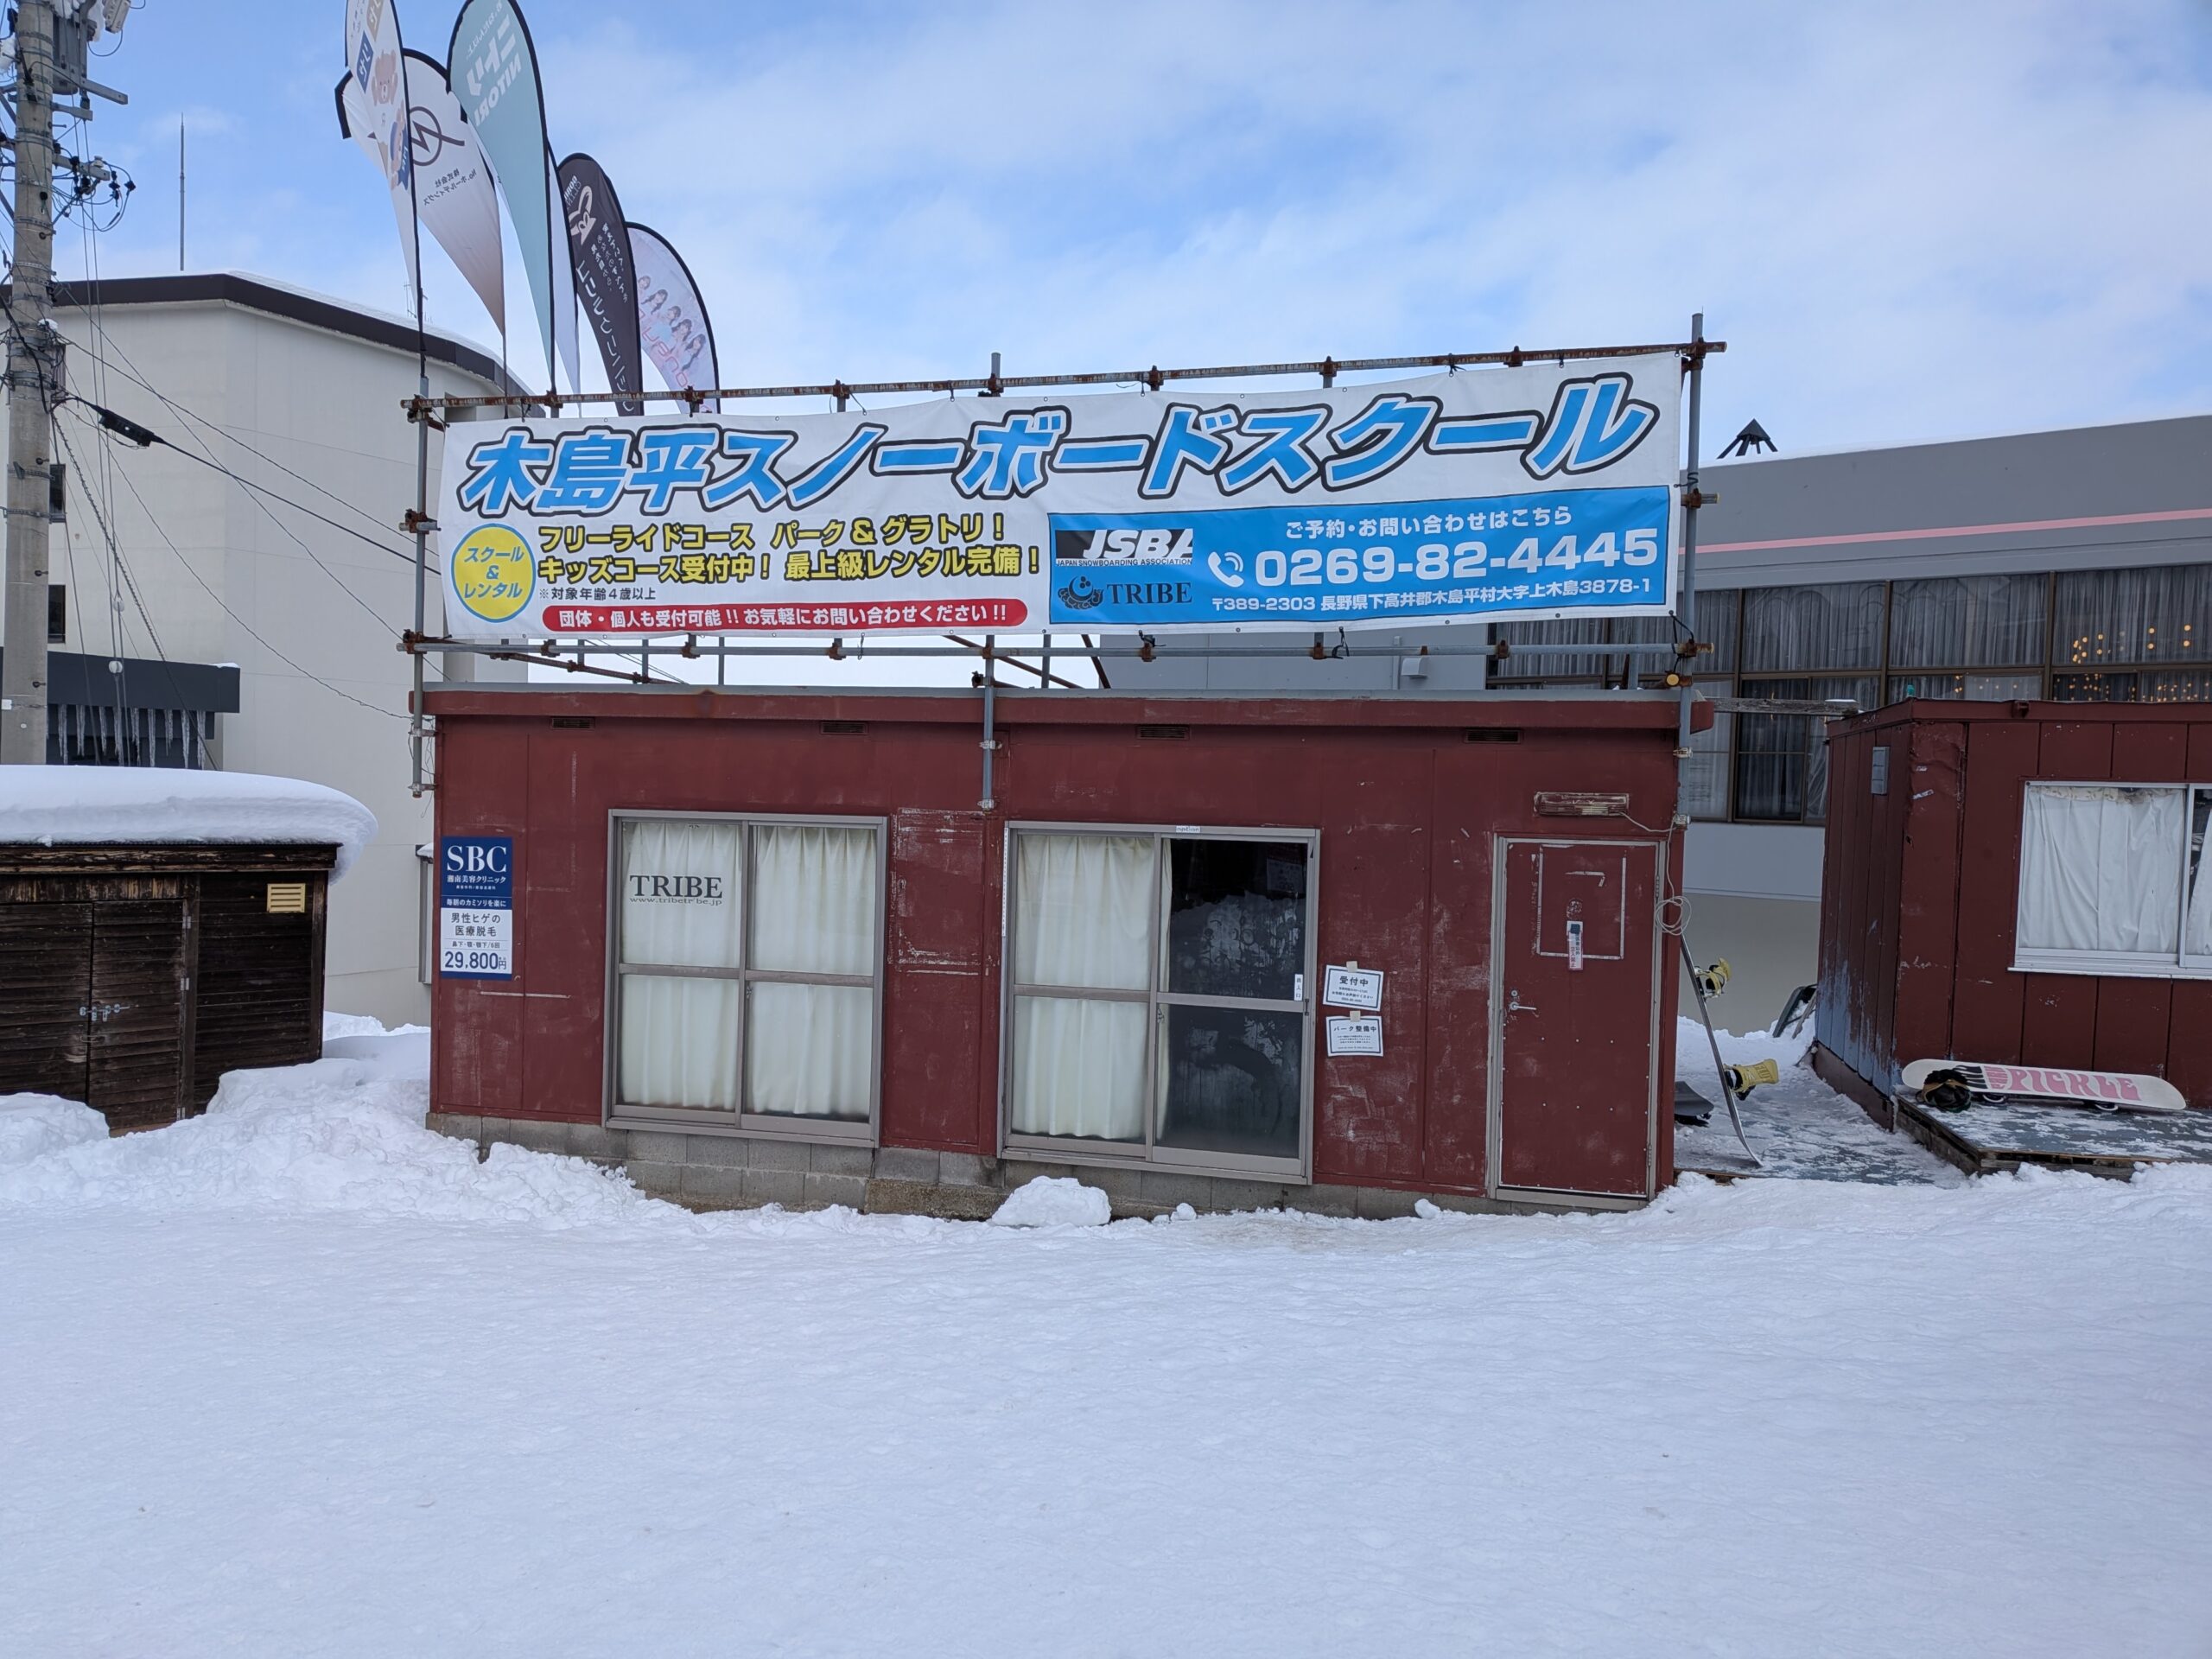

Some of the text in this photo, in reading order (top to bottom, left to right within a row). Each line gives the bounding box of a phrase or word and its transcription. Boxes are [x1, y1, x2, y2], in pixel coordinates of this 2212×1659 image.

[455, 371, 1659, 518] 木島平スノーボードスクール
[1285, 505, 1573, 540] ご予約・お問い合わせはこちら
[537, 522, 755, 553] フリーライドコース
[770, 518, 845, 549] パーク
[849, 517, 878, 546] &
[1083, 528, 1194, 559] JSBA
[464, 546, 524, 563] スクール
[1255, 527, 1658, 588] 0269-82-4445
[486, 565, 499, 580] &
[464, 582, 523, 600] レンタル
[1106, 582, 1193, 605] TRIBE
[1211, 577, 1650, 612] 〒389-2303 長野県下高井郡木島平村大字上木島3878-1
[447, 845, 507, 874] SBC
[447, 874, 507, 884] 湘南美容クリニック
[629, 874, 723, 899] TRIBE
[451, 912, 501, 924] 男性ヒゲの
[454, 925, 497, 938] 医療脱毛
[444, 950, 507, 970] 29,800円
[1339, 976, 1369, 987] 受付中
[1333, 1025, 1377, 1033] パーク整備中
[2007, 1067, 2142, 1102] PICKLE
